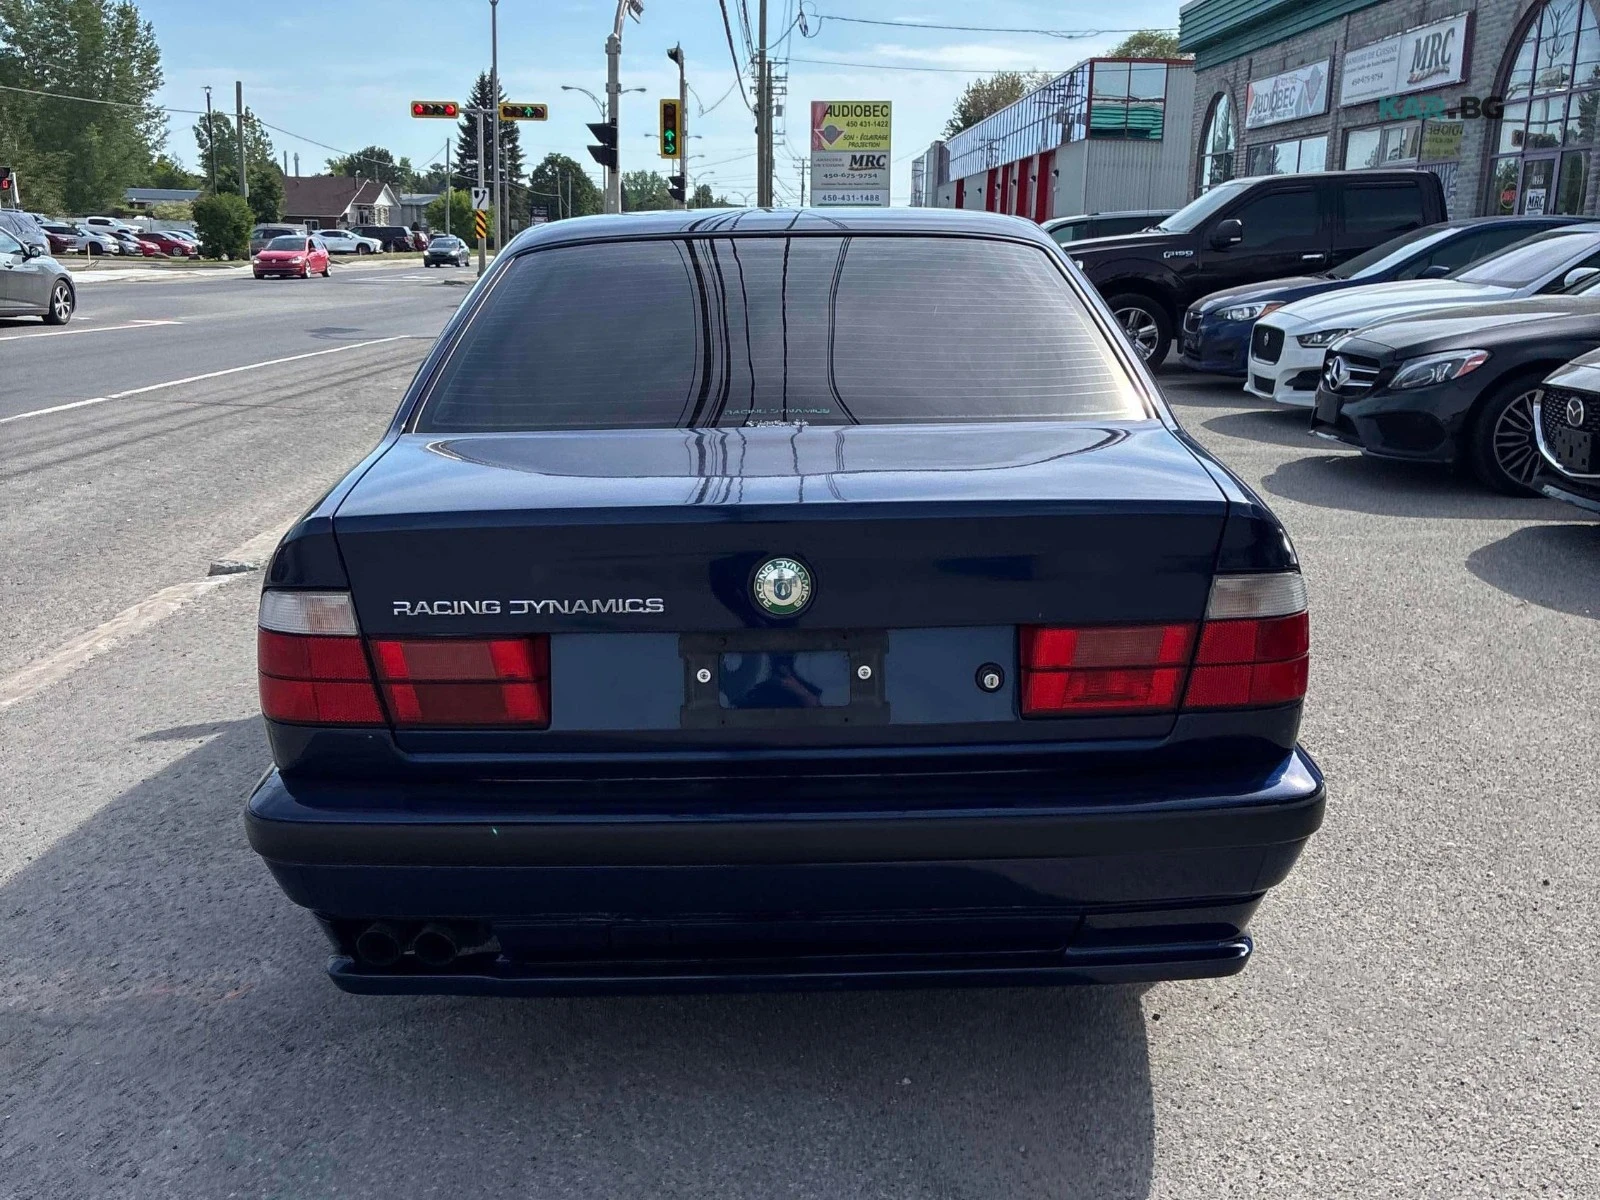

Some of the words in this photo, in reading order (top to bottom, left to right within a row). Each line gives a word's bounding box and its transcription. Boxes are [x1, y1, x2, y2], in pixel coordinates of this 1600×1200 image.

[1409, 27, 1455, 73] MRC
[1249, 86, 1296, 117] AUDIOBEC
[823, 104, 889, 118] AUDIOBEC
[848, 154, 887, 168] MRC
[822, 194, 880, 202] 450-431-1488
[1527, 195, 1545, 209] MRC
[756, 564, 775, 608] RACING
[776, 560, 810, 608] DYNAMICS
[393, 600, 501, 616] RACING
[509, 598, 665, 615] DYNAMICS
